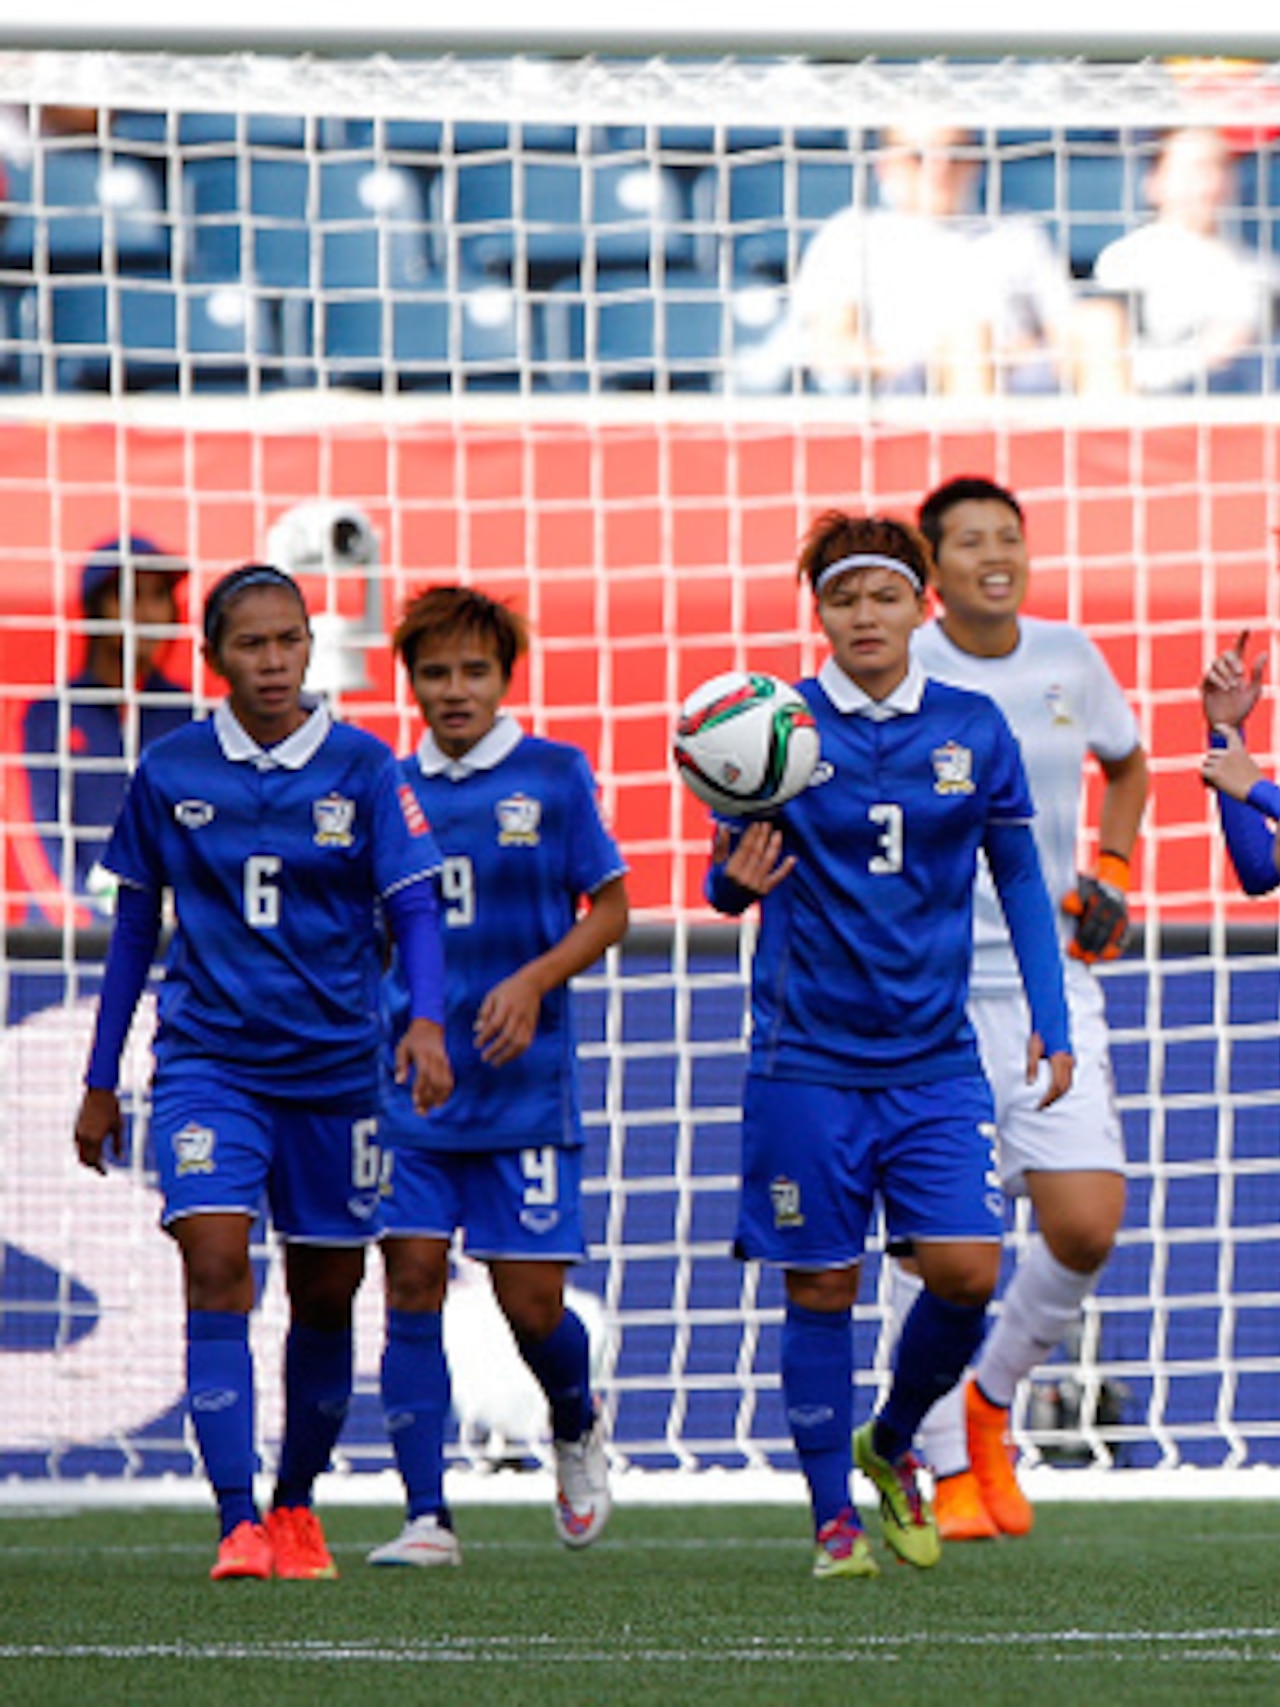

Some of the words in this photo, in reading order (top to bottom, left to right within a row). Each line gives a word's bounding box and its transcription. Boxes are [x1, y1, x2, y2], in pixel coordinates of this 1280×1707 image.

[868, 804, 903, 875] 3
[244, 855, 282, 928] 6
[441, 855, 475, 928] 9
[352, 1117, 379, 1188] 6
[521, 1145, 558, 1206] 9
